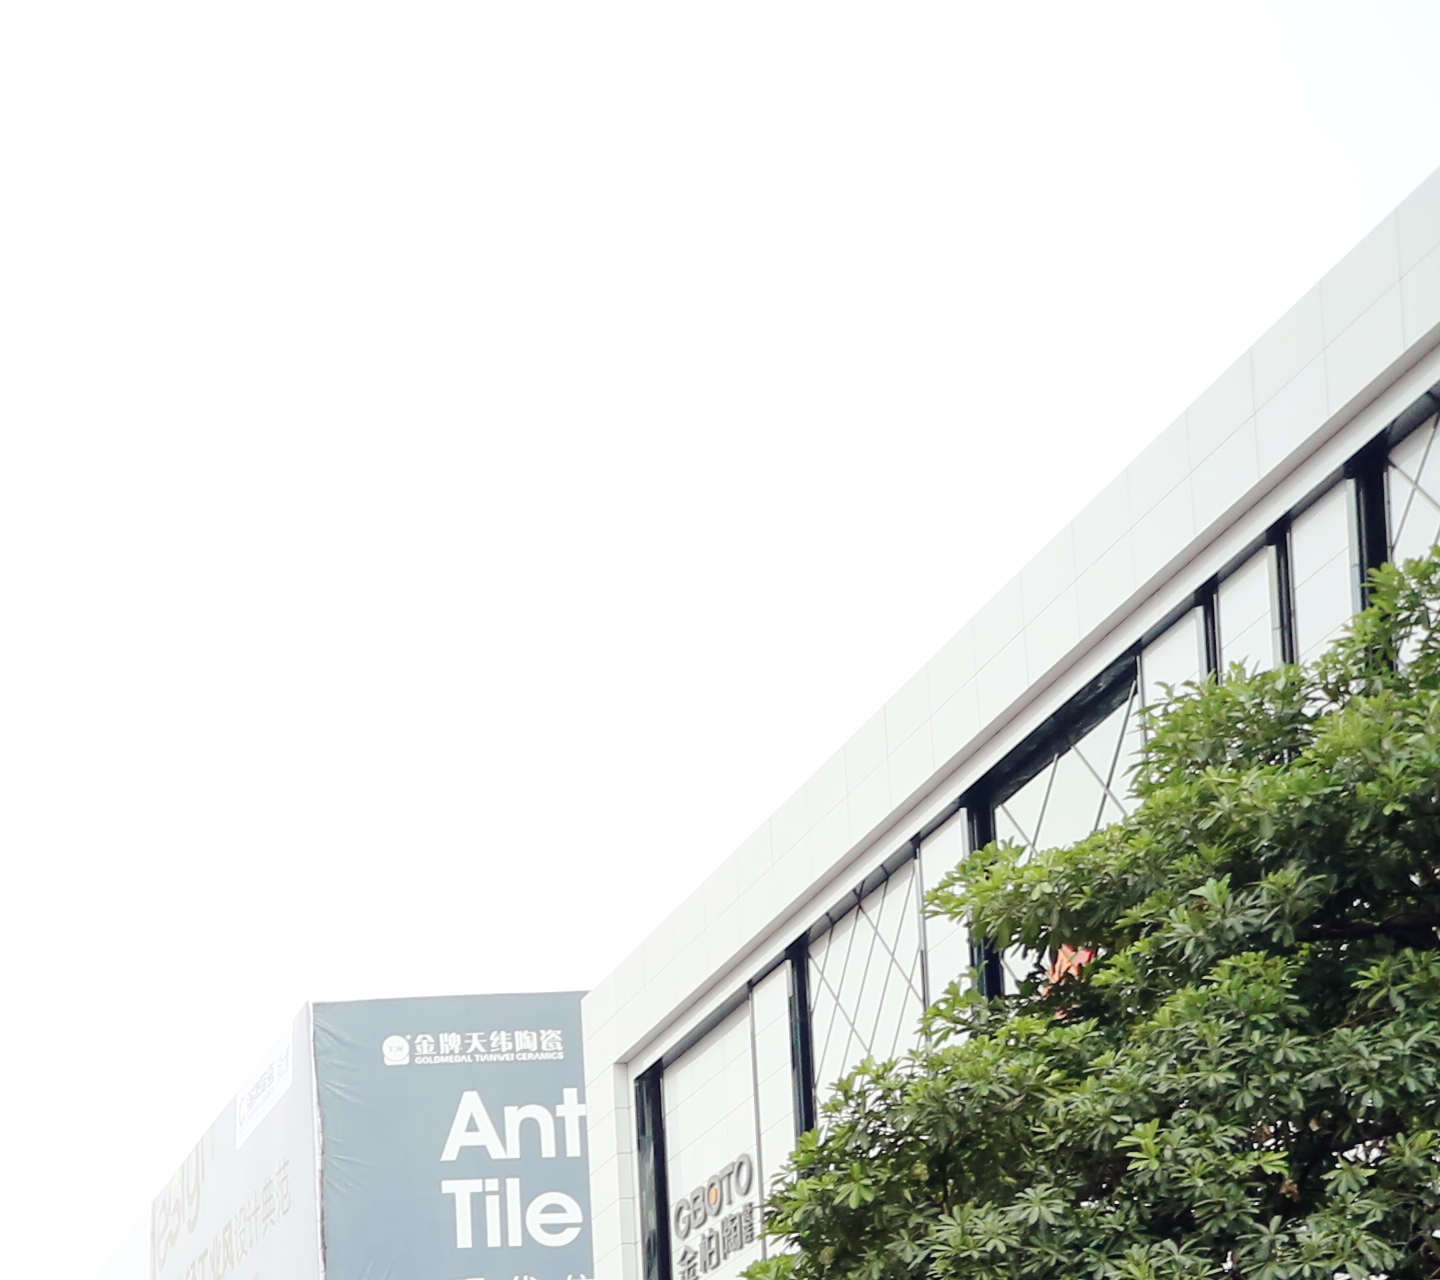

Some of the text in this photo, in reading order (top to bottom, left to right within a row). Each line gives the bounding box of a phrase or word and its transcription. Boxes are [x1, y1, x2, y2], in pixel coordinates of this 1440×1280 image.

[414, 1029, 564, 1055] 金牌天纬陶瓷
[415, 1054, 473, 1065] GOLDMEDAL
[516, 1050, 564, 1062] CERAMICS
[439, 1087, 587, 1162] Ant
[440, 1176, 585, 1250] Tile
[674, 1153, 753, 1240] GBOTO
